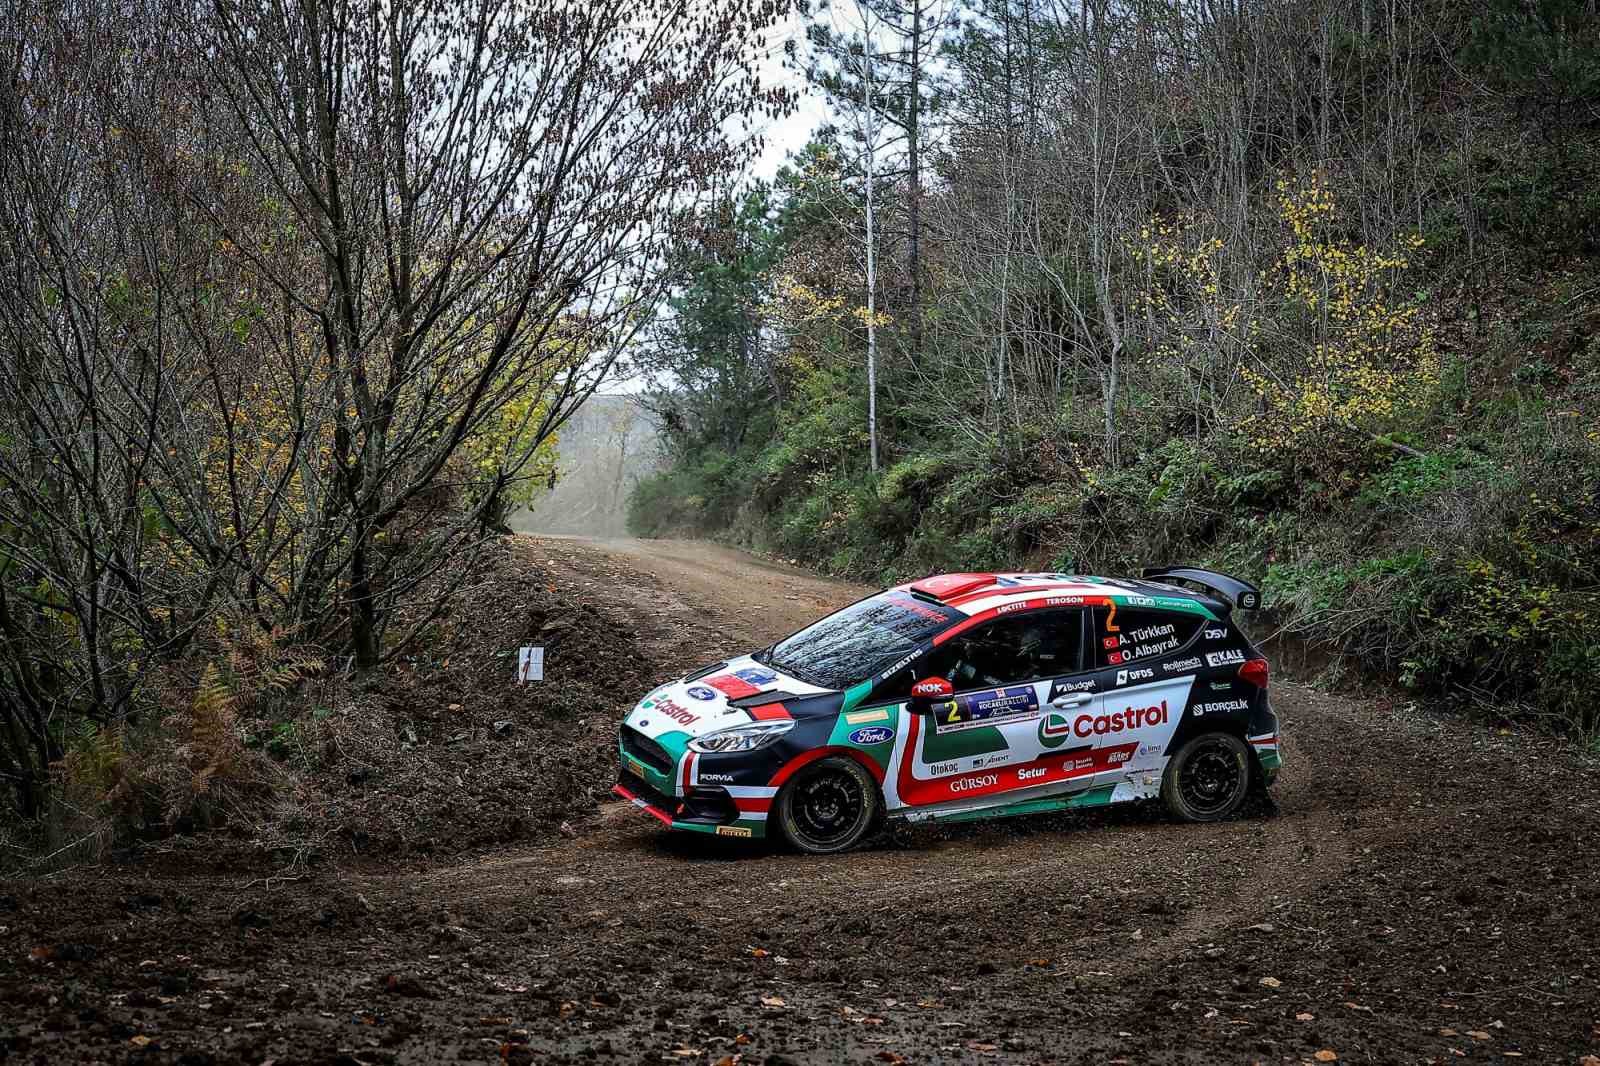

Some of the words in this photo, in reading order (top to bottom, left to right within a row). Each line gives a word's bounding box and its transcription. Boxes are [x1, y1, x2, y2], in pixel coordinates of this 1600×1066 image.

[1045, 596, 1084, 605] TEROSON
[997, 601, 1027, 614] LOCTITE
[1103, 598, 1120, 632] 2
[1119, 633, 1131, 646] A.
[1129, 623, 1175, 643] Türkkan
[1205, 627, 1228, 640] DSV
[1129, 668, 1154, 680] DFDS
[917, 683, 943, 693] NGK
[1066, 680, 1096, 691] Budget
[655, 699, 701, 726] Castrol
[944, 700, 961, 722] 2
[1073, 700, 1169, 738] Castrol
[857, 728, 886, 743] Ford
[930, 762, 959, 776] Otokoç
[1017, 767, 1047, 780] Setur
[700, 773, 734, 782] FORVIA
[950, 773, 999, 793] GÜRSOY
